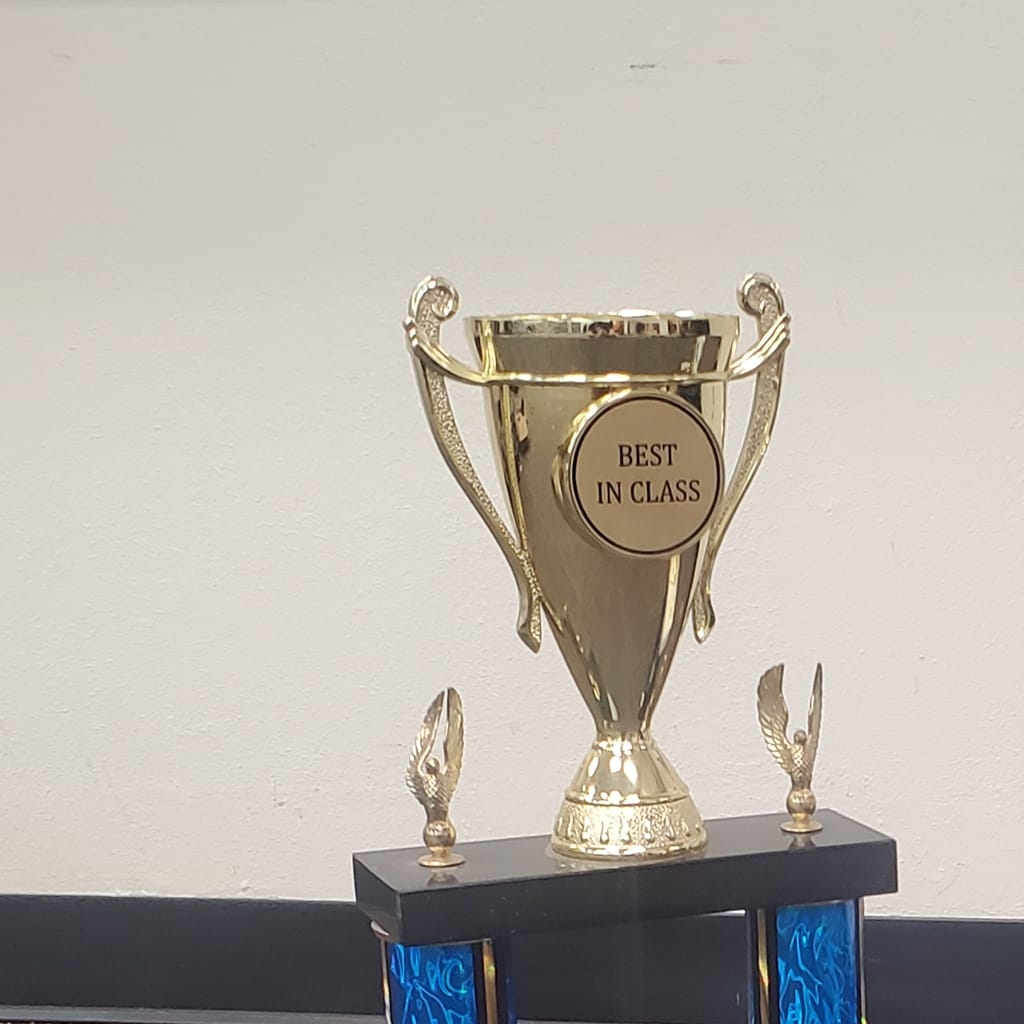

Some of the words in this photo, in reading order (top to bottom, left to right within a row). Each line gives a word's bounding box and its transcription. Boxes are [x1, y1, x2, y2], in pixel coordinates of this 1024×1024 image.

[618, 443, 678, 467] BEST
[597, 481, 622, 504] IN
[630, 479, 701, 504] CLASS
